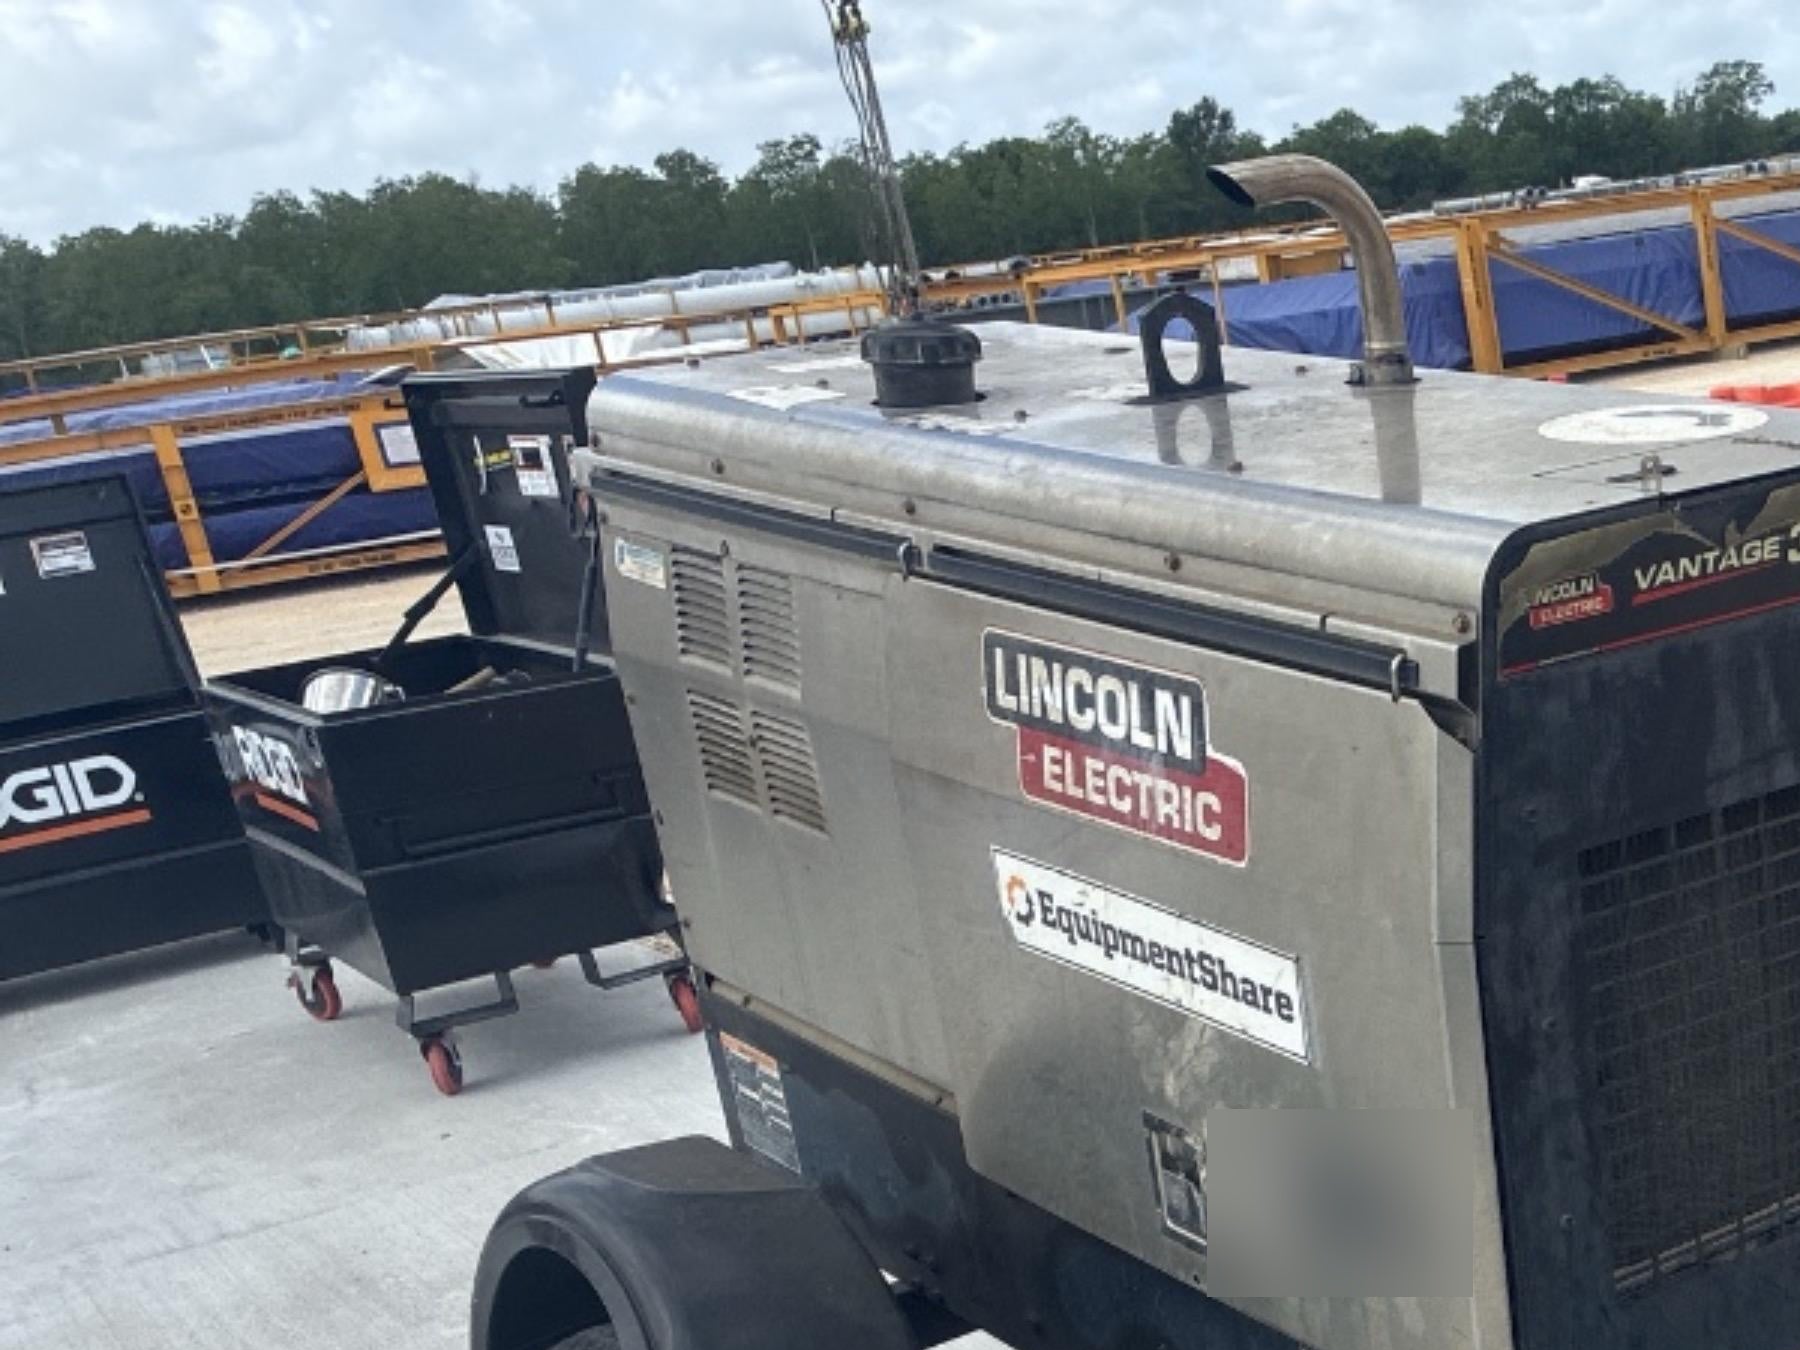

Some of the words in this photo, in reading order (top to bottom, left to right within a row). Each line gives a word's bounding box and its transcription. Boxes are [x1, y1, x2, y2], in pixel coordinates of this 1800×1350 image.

[1634, 535, 1781, 591] VANTAGE
[994, 646, 1193, 761] LINCOLN
[0, 754, 137, 829] GID
[1042, 743, 1223, 842] ELECTRIC
[1036, 888, 1295, 1024] EquipmentShare
